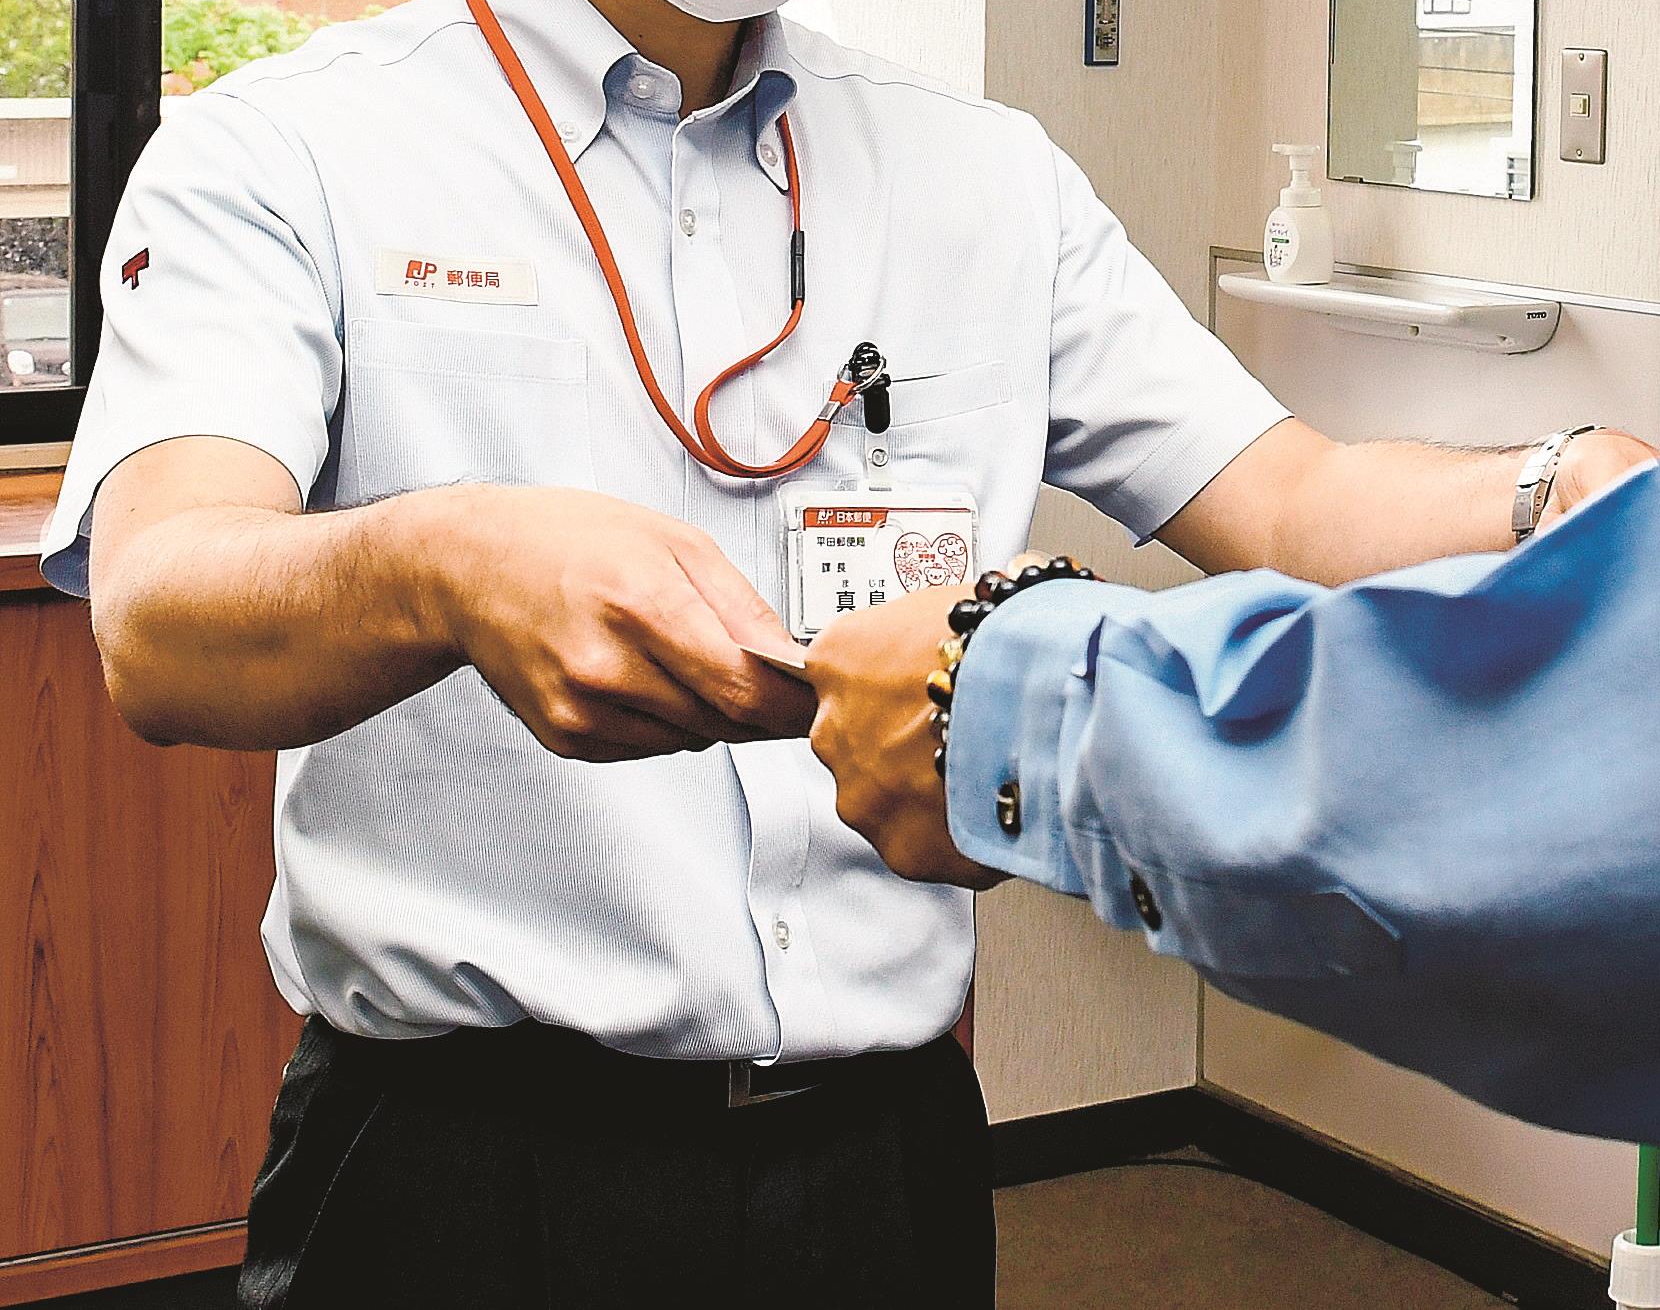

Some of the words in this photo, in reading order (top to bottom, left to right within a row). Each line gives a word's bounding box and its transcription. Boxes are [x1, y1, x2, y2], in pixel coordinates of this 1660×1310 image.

[446, 269, 501, 289] 郵便局
[836, 511, 872, 523] 日本郵便
